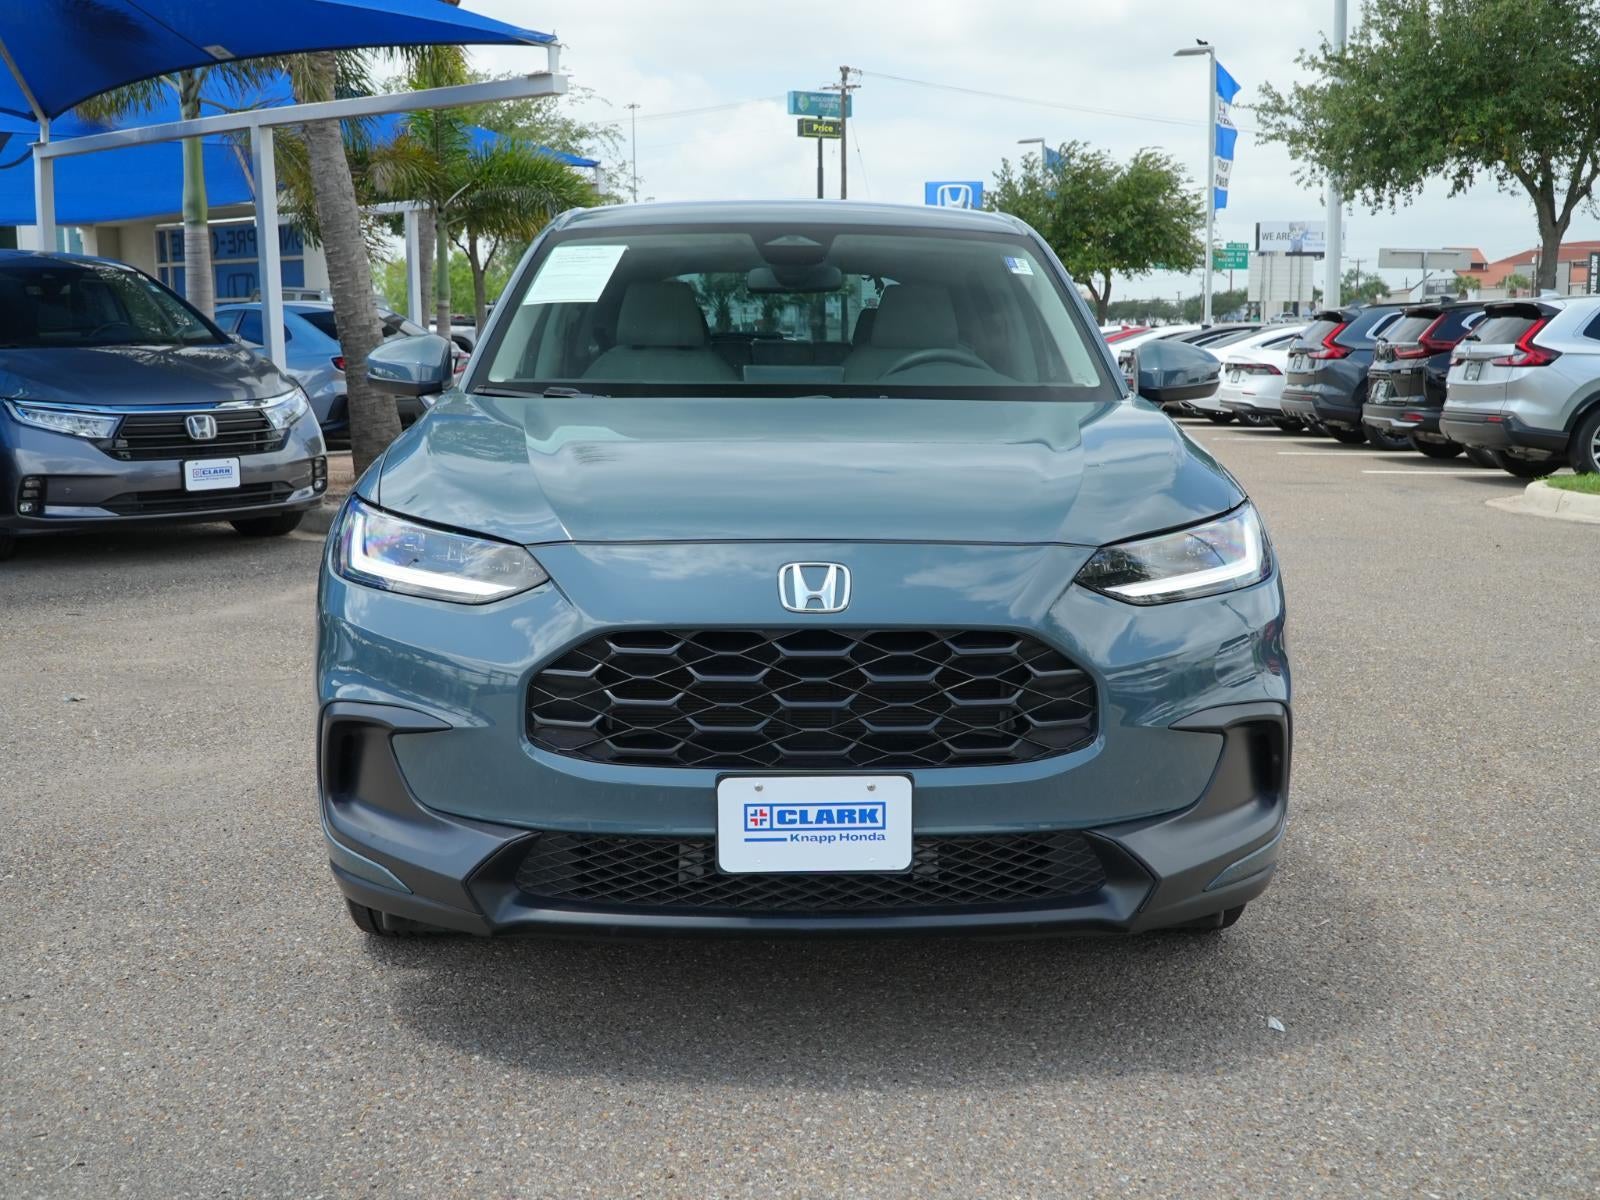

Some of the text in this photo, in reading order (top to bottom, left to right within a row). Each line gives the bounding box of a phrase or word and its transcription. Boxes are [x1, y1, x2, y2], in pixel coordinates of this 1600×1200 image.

[813, 124, 833, 132] Price
[1262, 231, 1292, 241] WE ARE
[776, 808, 879, 825] CLARK
[789, 832, 886, 844] Knapp Honda
